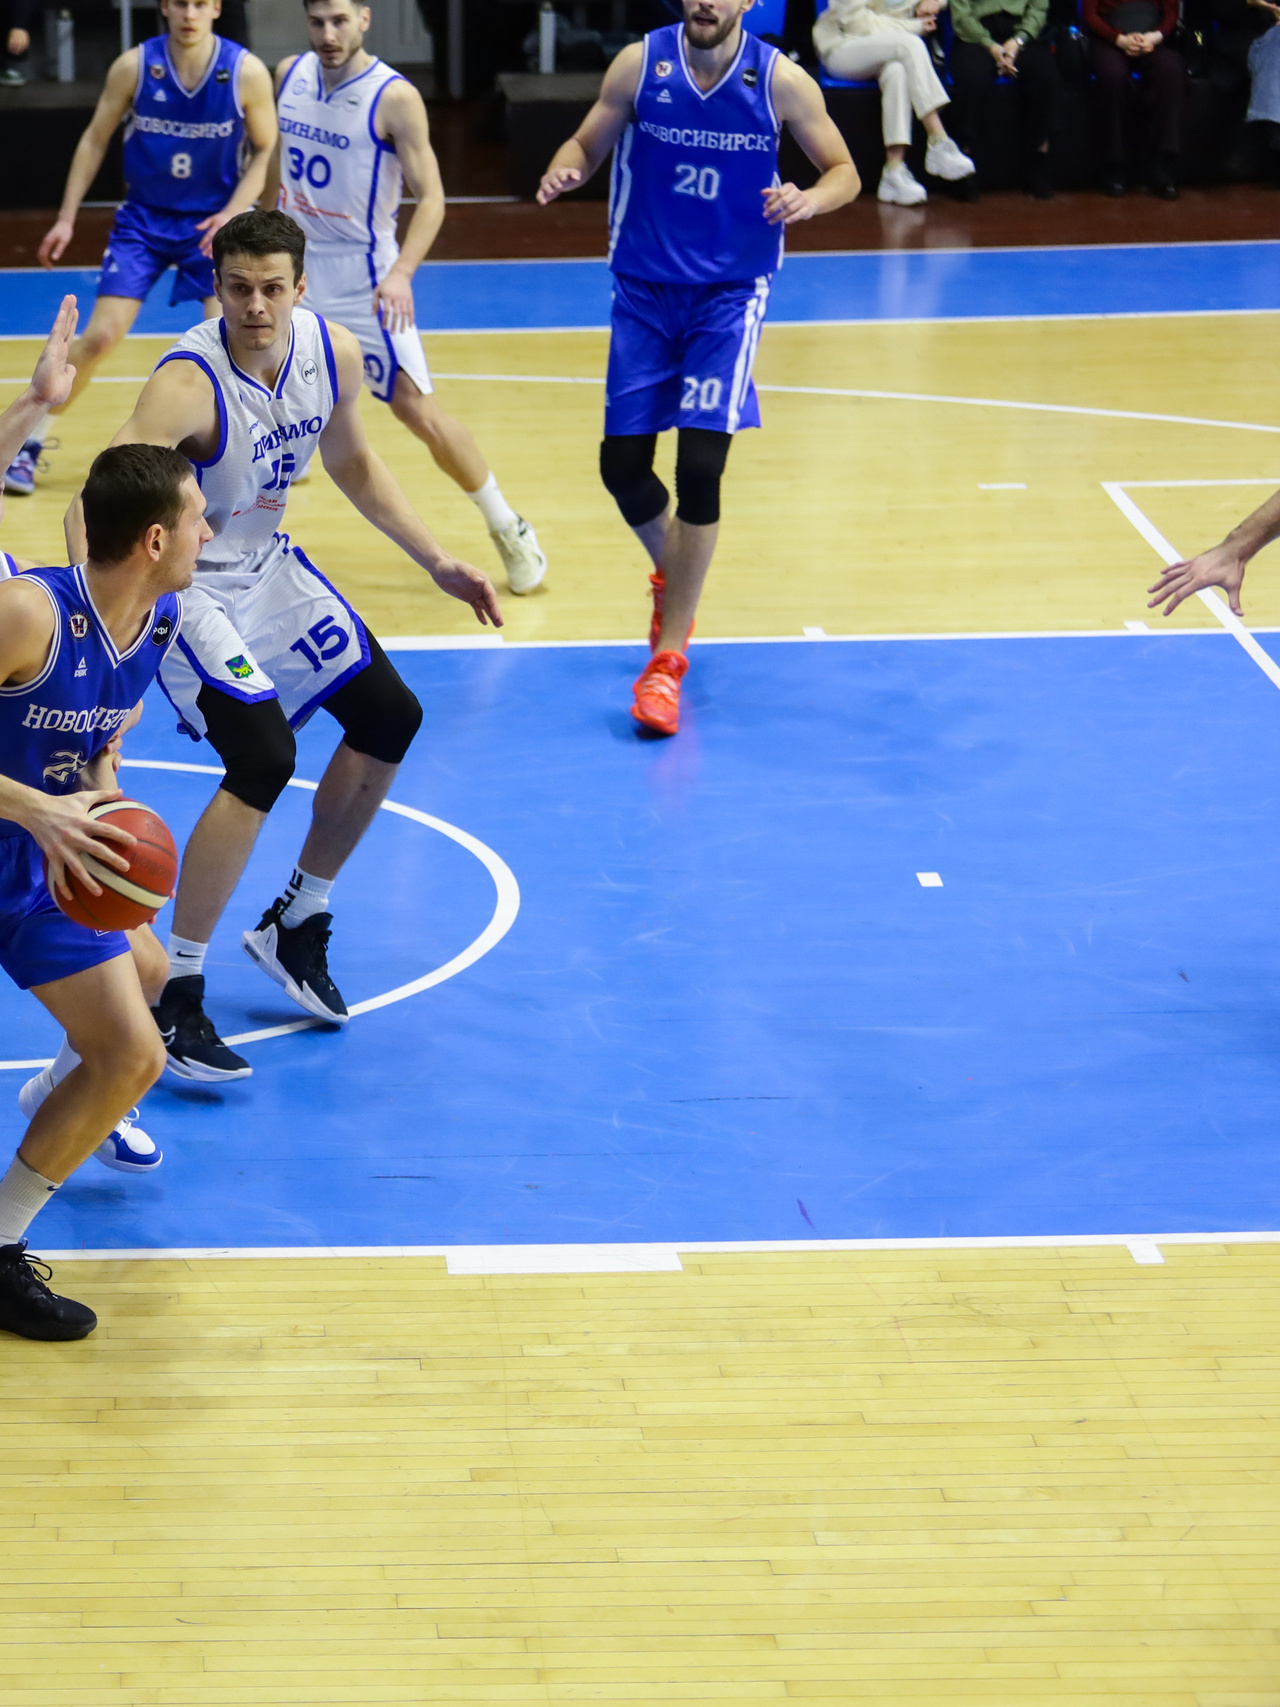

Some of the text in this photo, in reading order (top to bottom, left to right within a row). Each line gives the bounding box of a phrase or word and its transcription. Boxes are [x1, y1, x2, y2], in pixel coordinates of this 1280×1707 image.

[171, 152, 192, 178] 8
[287, 146, 332, 190] 30
[673, 163, 720, 200] 20
[680, 376, 722, 411] 20
[289, 614, 350, 674] 15
